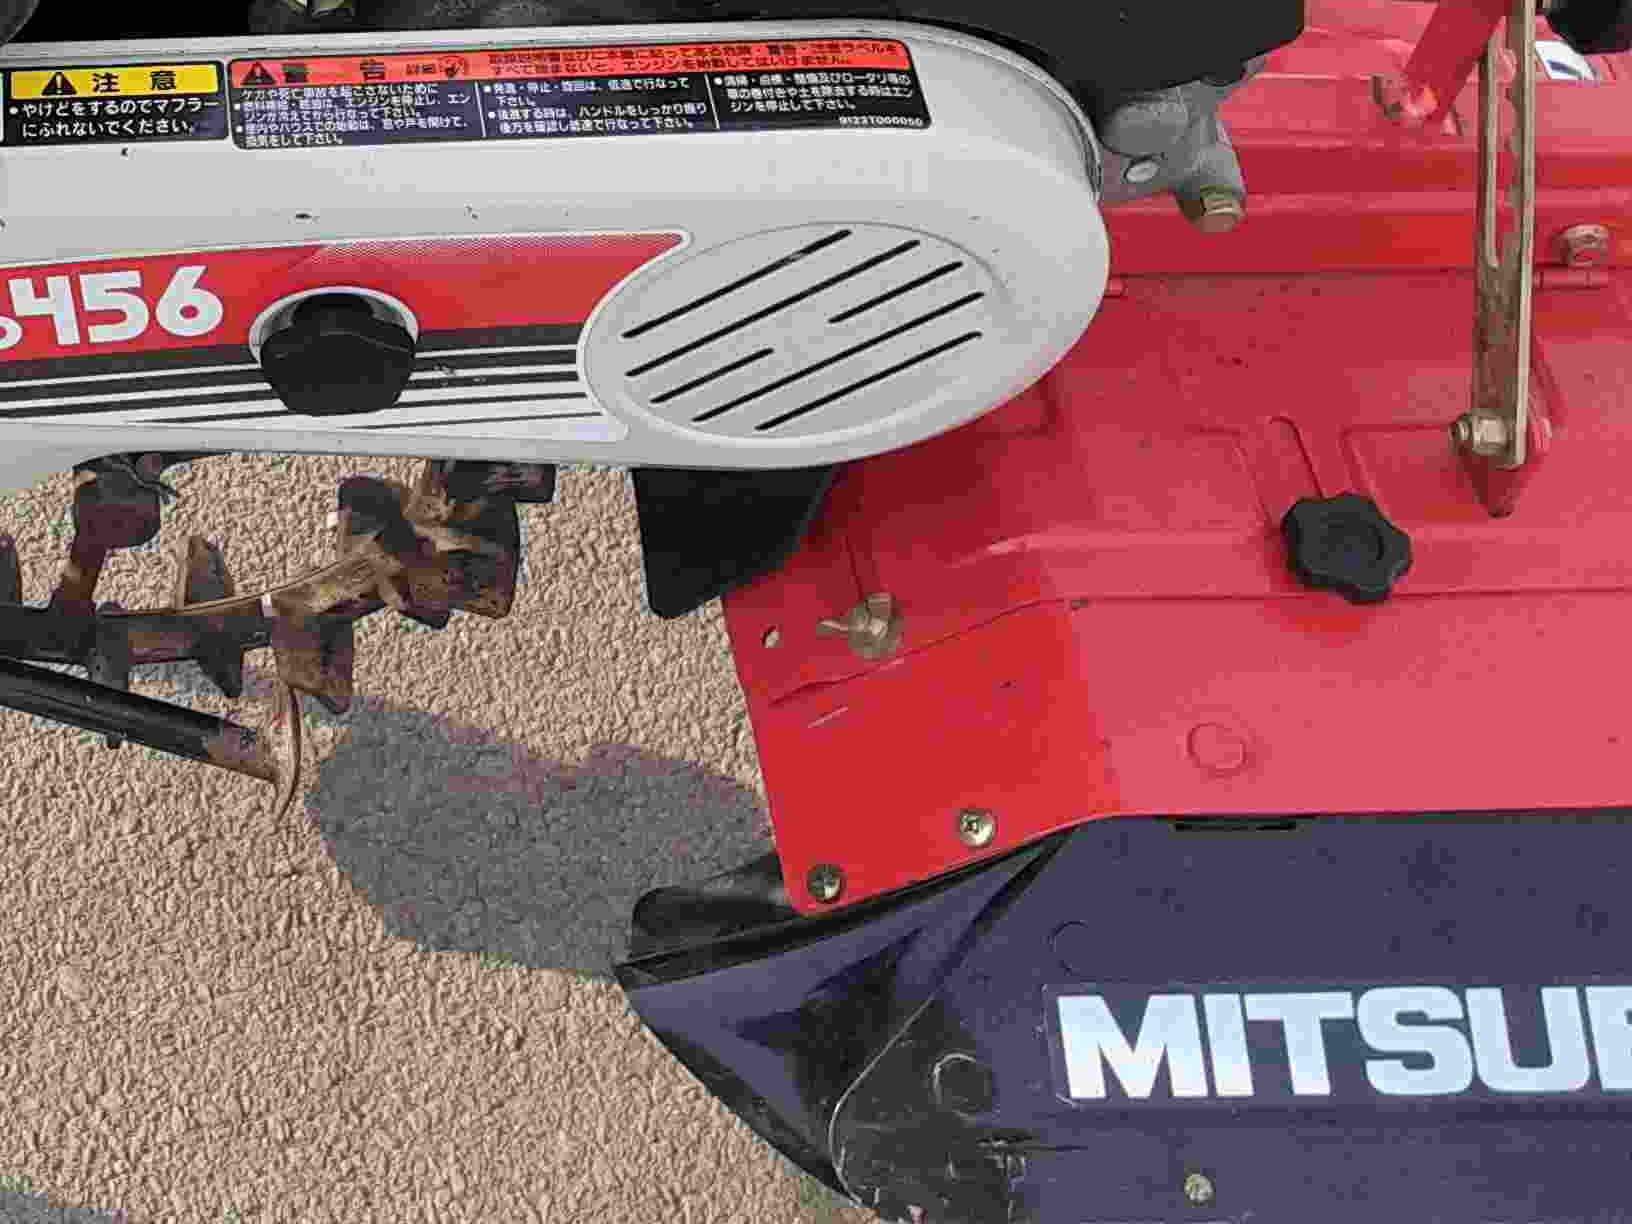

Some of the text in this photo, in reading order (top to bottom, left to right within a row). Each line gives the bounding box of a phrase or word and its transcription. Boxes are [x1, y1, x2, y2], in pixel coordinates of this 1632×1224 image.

[91, 71, 177, 93] 注意
[22, 97, 219, 117] やけどをするのでマフラー
[22, 118, 193, 137] にふれないでください。
